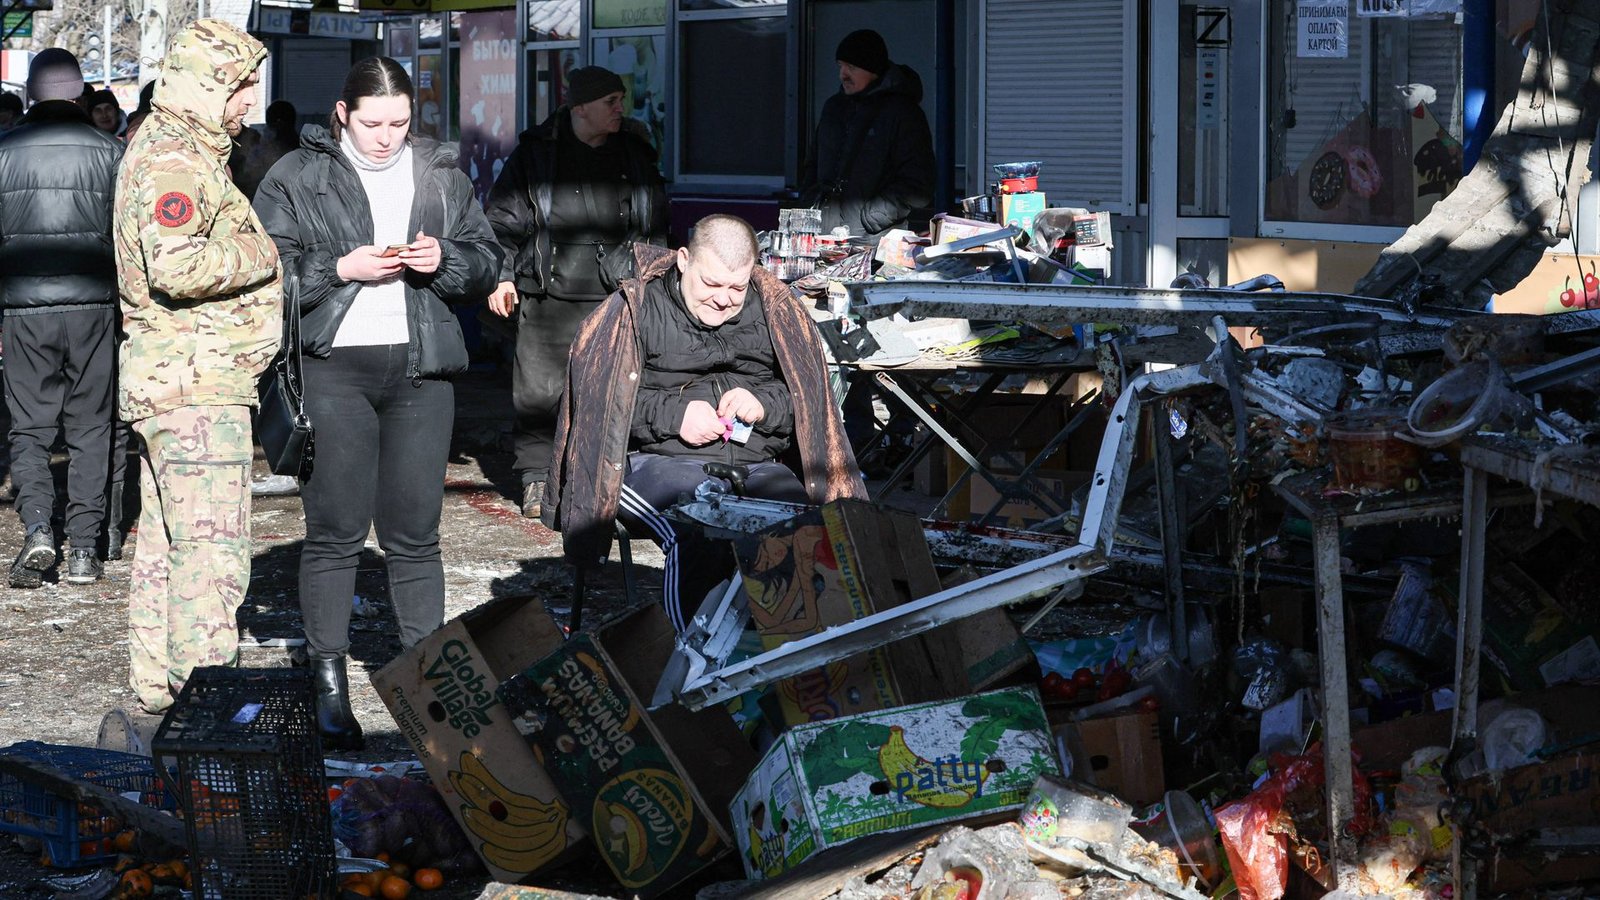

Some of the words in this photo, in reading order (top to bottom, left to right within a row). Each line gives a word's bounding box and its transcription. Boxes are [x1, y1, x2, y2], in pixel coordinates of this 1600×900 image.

[1196, 11, 1227, 44] Z
[1298, 6, 1347, 18] ПРИНИМАЕМ
[1308, 22, 1338, 34] ОПЛАТУ
[1308, 36, 1338, 50] КАРТОЙ
[424, 655, 481, 739] Village
[441, 639, 500, 711] Global
[591, 671, 629, 719] ECUADOR
[391, 686, 428, 736] Premium
[541, 676, 619, 773] PREMIUM
[558, 657, 636, 756] BANANAS
[396, 713, 432, 760] bananas
[636, 771, 689, 830] BANANAS
[896, 753, 983, 803] patty
[906, 790, 942, 801] Bananas
[943, 783, 977, 794] Ecuador
[759, 831, 785, 868] patty
